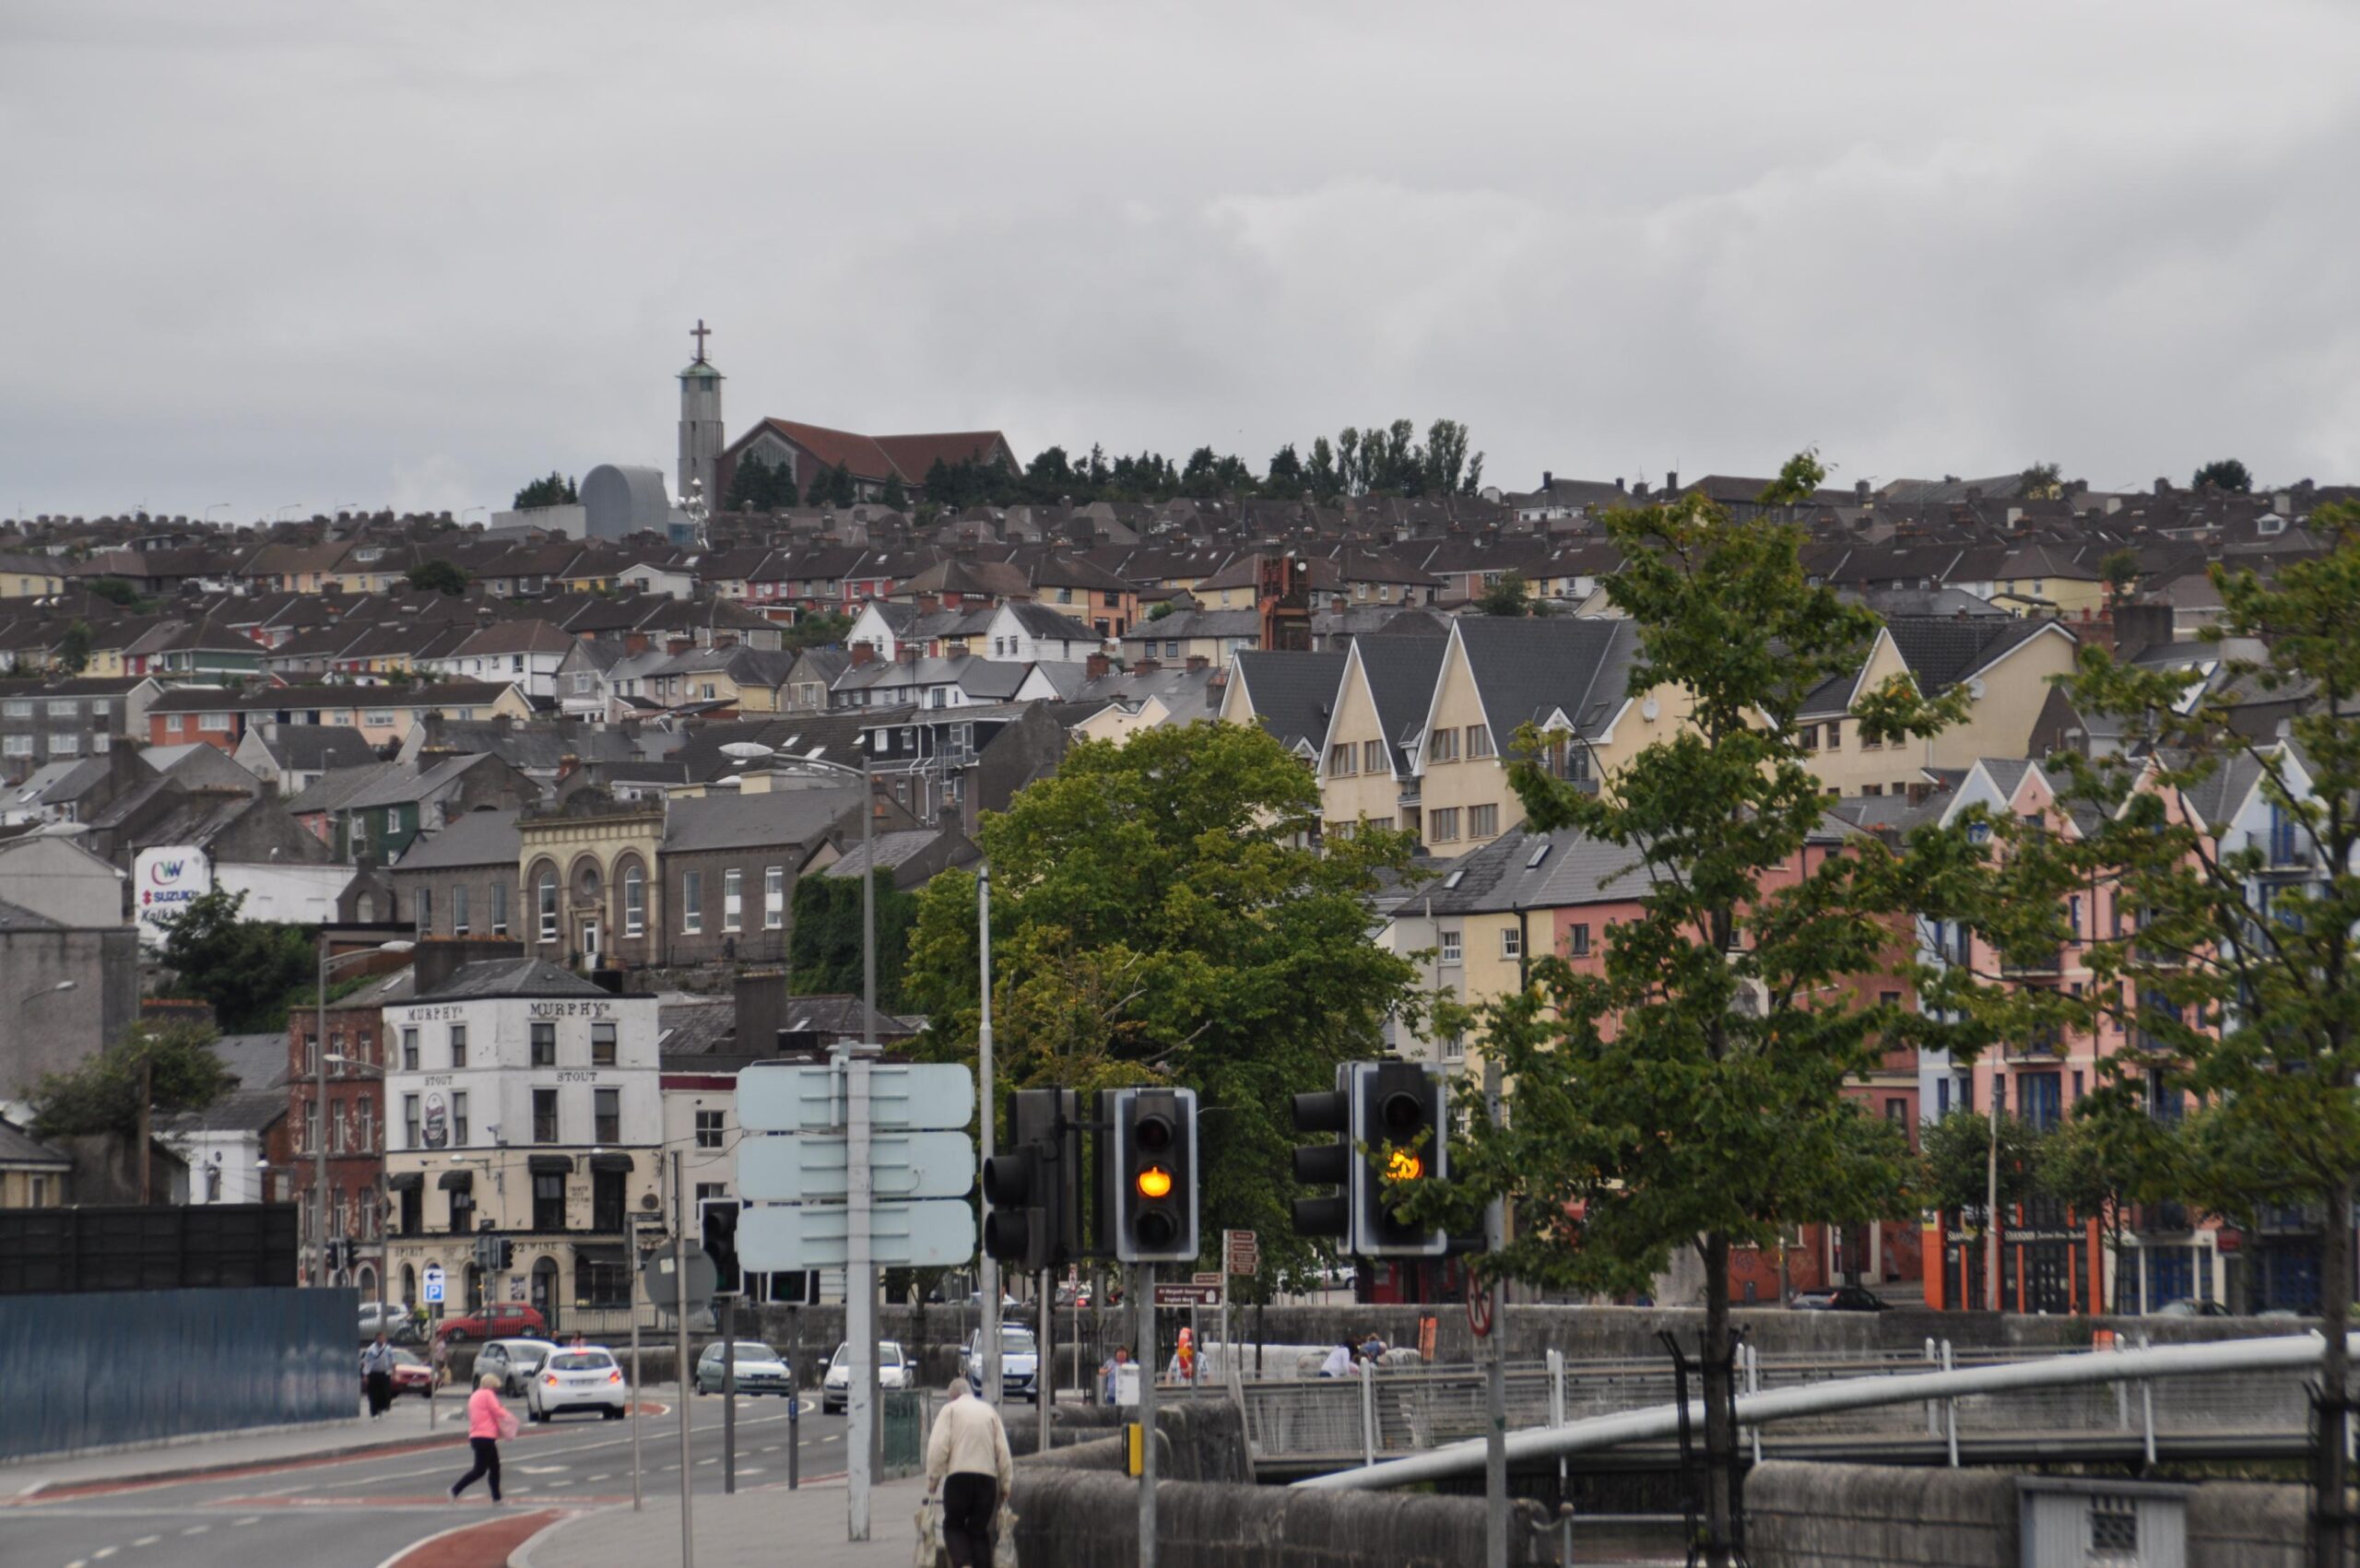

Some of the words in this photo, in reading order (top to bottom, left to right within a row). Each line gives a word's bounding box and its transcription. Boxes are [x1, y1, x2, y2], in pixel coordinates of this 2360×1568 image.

[424, 1075, 454, 1086] STOUT
[556, 1071, 597, 1082] STOUT
[530, 1242, 560, 1251] WINE
[429, 1285, 440, 1299] P
